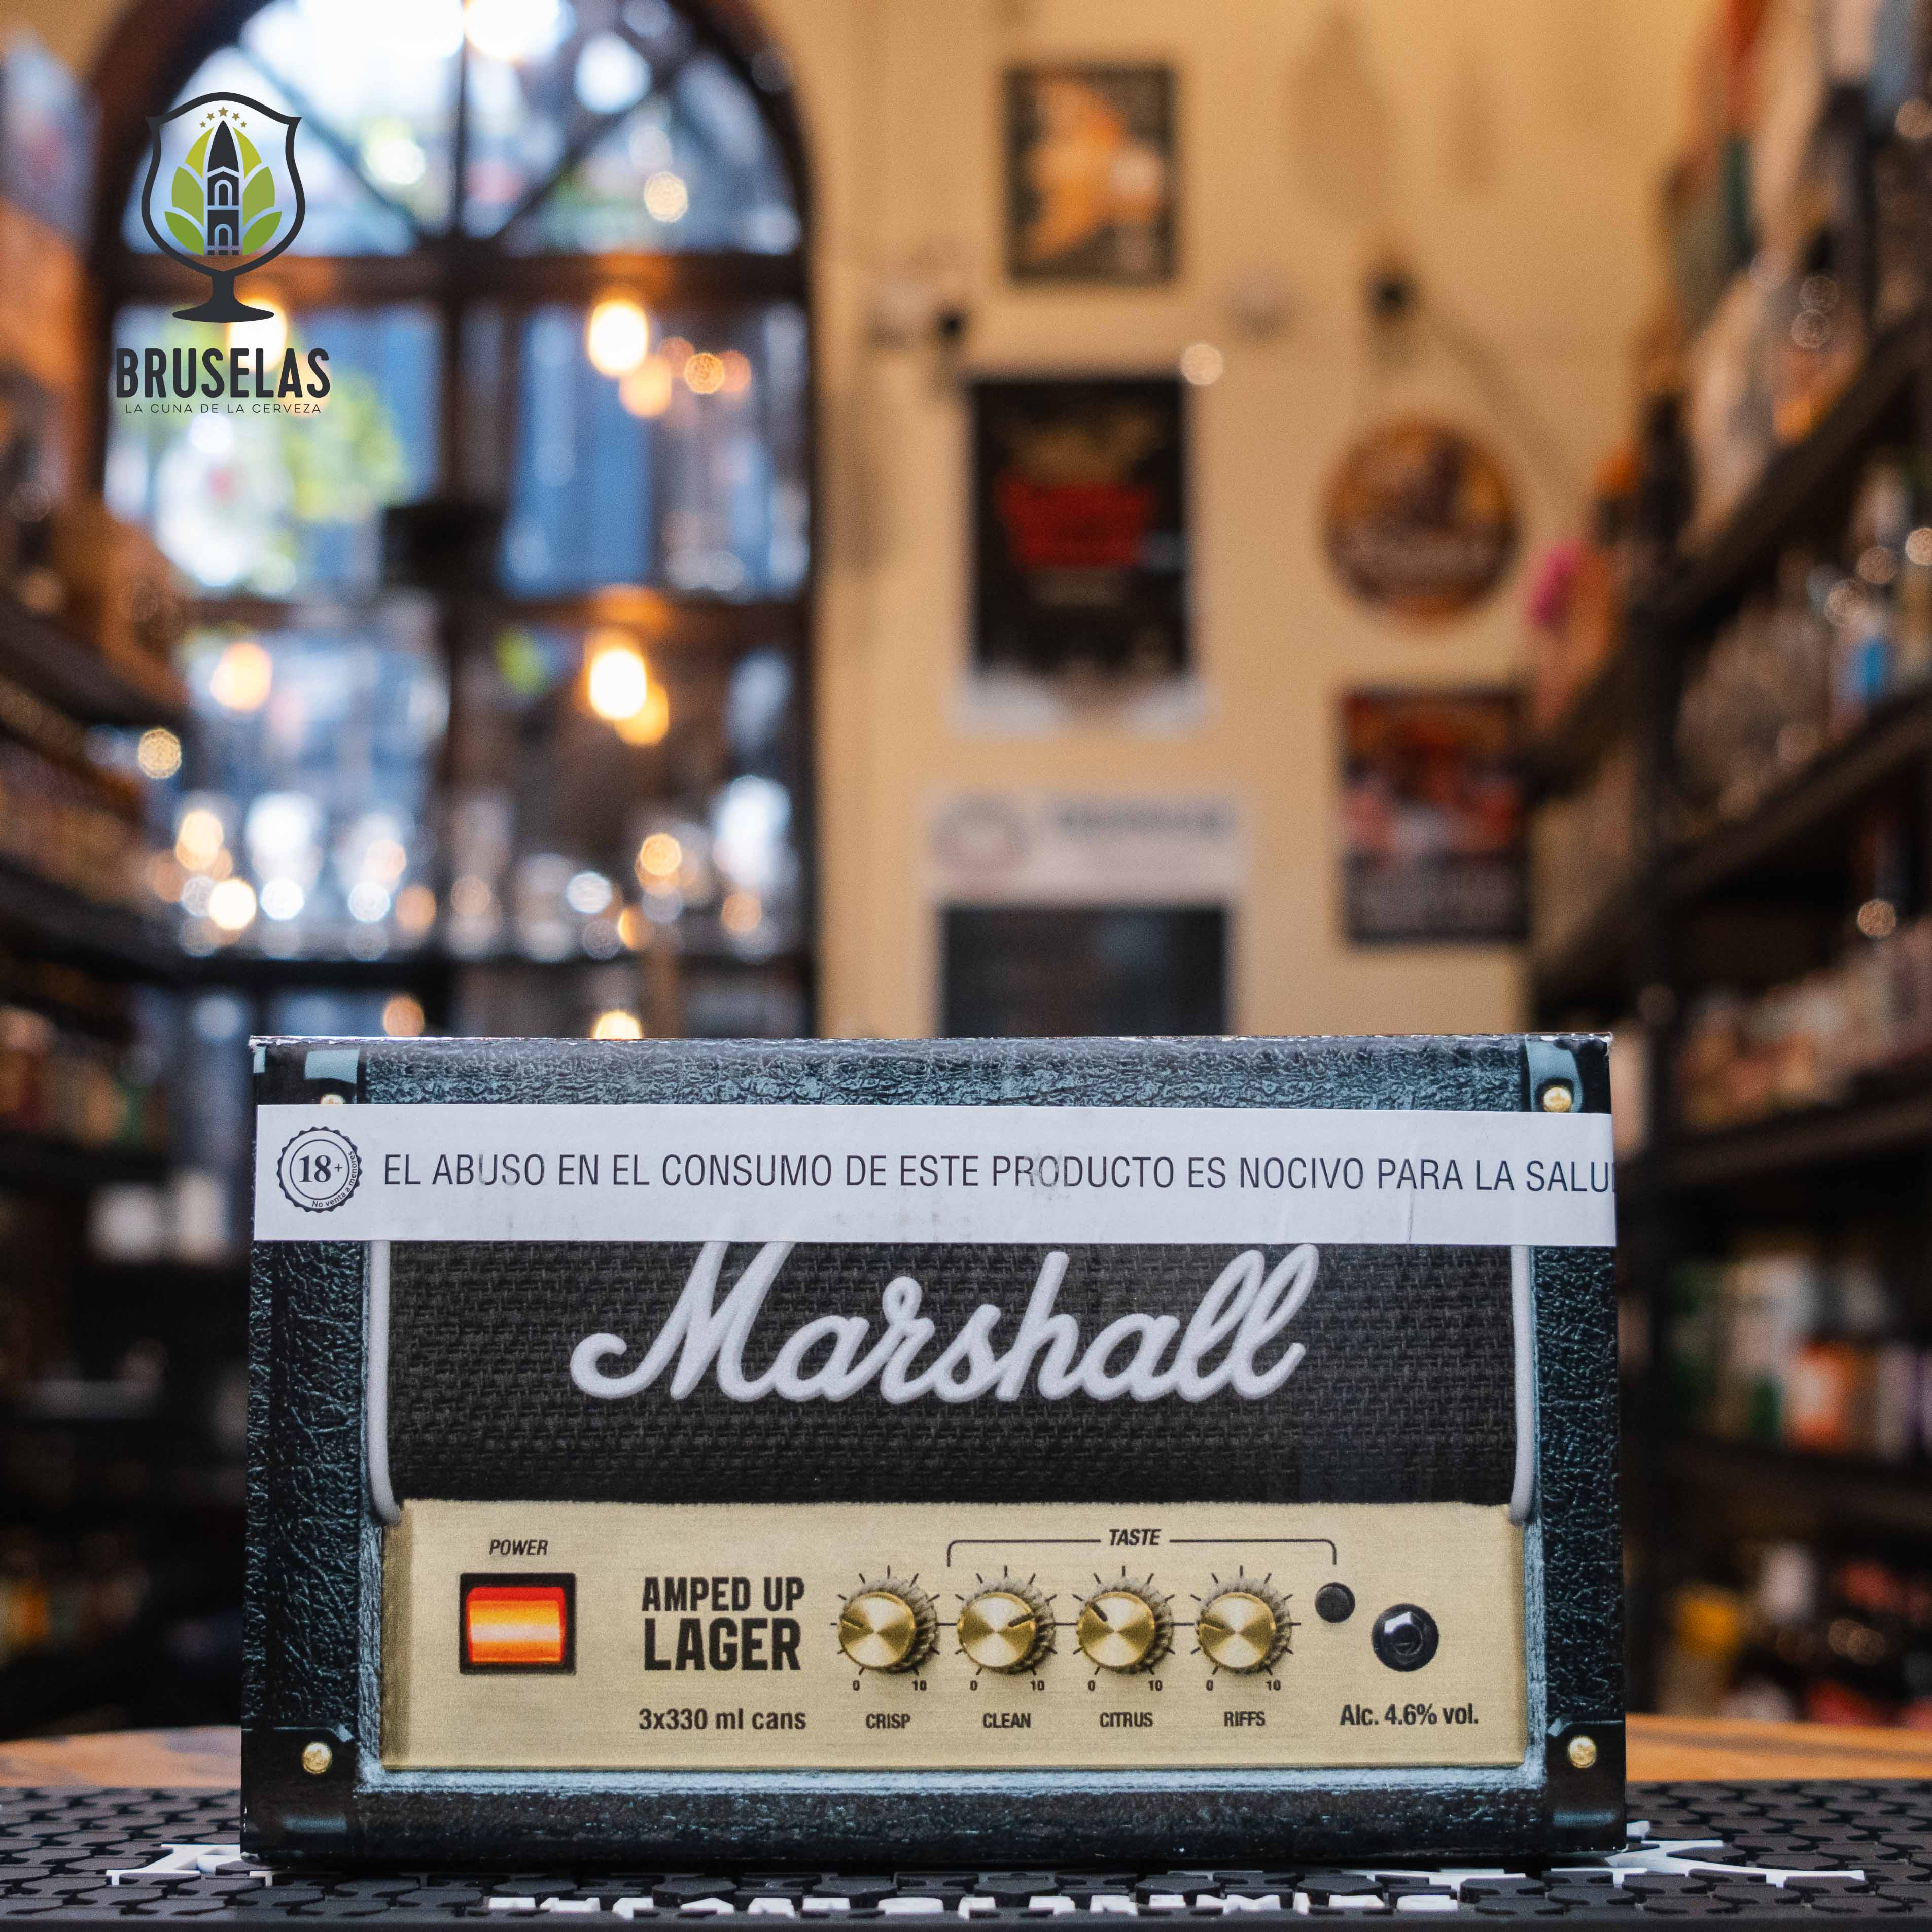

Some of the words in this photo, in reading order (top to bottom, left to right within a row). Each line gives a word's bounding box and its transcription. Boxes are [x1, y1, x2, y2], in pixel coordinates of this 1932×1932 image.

[299, 1154, 343, 1183] 18+
[385, 1154, 421, 1185] EL
[432, 1154, 545, 1186] ABUSO
[559, 1154, 599, 1185] EN
[613, 1154, 650, 1185] EL
[662, 1154, 831, 1186] CONSUMO
[847, 1155, 887, 1186] DE
[900, 1155, 978, 1187] ESTE
[993, 1155, 1174, 1188] PRODUCTO
[1188, 1156, 1226, 1188] ES
[1240, 1157, 1363, 1189] NOCIVO
[1378, 1158, 1463, 1190] PARA
[1476, 1160, 1515, 1191] LA
[1527, 1160, 1615, 1193] SALU
[325, 1192, 346, 1206] venta
[348, 1150, 358, 1186] menores
[570, 1242, 1319, 1405] Marshall
[1109, 1528, 1162, 1546] TASTE
[487, 1539, 548, 1556] POWER
[642, 1576, 751, 1612] AMPED
[764, 1576, 805, 1612] UP
[644, 1617, 801, 1671] LAGER
[852, 1680, 860, 1691] 0
[912, 1679, 927, 1691] 10
[970, 1680, 978, 1691] 0
[1030, 1680, 1045, 1691] 10
[1087, 1680, 1096, 1692] 0
[1148, 1680, 1163, 1692] 10
[1206, 1679, 1214, 1691] 0
[1266, 1679, 1281, 1691] 10
[639, 1708, 708, 1730] 3x330
[716, 1708, 744, 1730] ml
[751, 1712, 806, 1730] cans
[865, 1713, 911, 1729] CRISP
[982, 1712, 1031, 1729] CLEAN
[1099, 1712, 1153, 1728] CITRUS
[1223, 1711, 1266, 1727] RIFFS
[1340, 1704, 1379, 1726] Alc.
[1384, 1703, 1437, 1726] 4.6%
[1442, 1703, 1479, 1725] vol.
